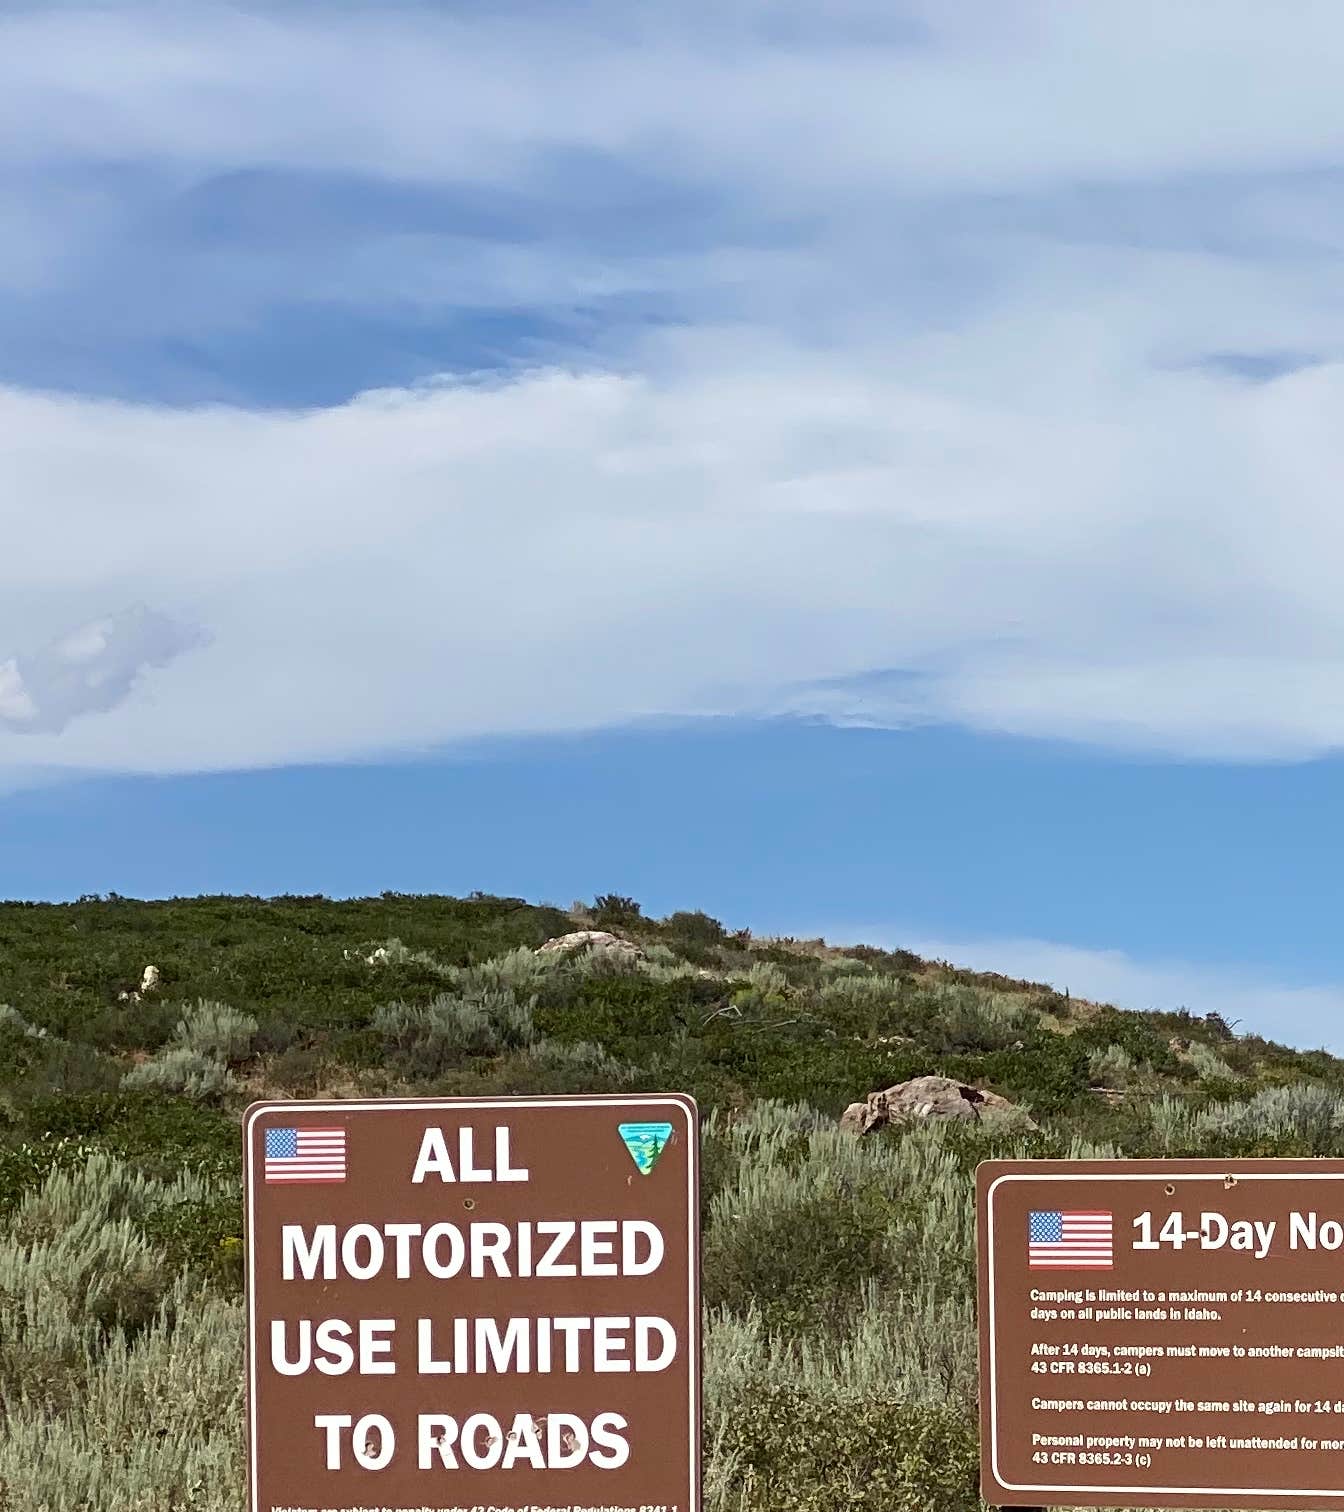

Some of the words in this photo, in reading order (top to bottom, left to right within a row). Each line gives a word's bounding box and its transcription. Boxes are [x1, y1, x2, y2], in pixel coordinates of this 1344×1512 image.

[411, 1126, 529, 1184] ALL
[1132, 1211, 1277, 1259] 14-Day
[282, 1220, 665, 1280] MOTORIZED
[1030, 1288, 1084, 1304] Camping
[1085, 1289, 1097, 1302] is
[1098, 1289, 1140, 1302] limited
[1142, 1289, 1156, 1302] to
[1168, 1289, 1228, 1302] maximum
[1230, 1289, 1243, 1302] of
[1245, 1289, 1263, 1303] 14
[1264, 1289, 1340, 1303] consecutive
[1030, 1306, 1058, 1322] days
[1059, 1309, 1076, 1320] on
[1077, 1307, 1093, 1320] all
[1095, 1307, 1133, 1322] public
[1134, 1307, 1168, 1321] lands
[1169, 1306, 1182, 1320] in
[1184, 1307, 1222, 1321] Idaho.
[271, 1318, 396, 1376] USE
[418, 1316, 677, 1374] LIMITED
[1030, 1343, 1061, 1356] After
[1062, 1343, 1079, 1357] 14
[1080, 1343, 1111, 1359] days,
[1113, 1346, 1165, 1359] campers
[1166, 1344, 1197, 1357] must
[1198, 1347, 1231, 1357] move
[1232, 1344, 1246, 1358] to
[1247, 1344, 1295, 1358] another
[1030, 1361, 1048, 1374] 43
[1049, 1361, 1075, 1374] CFR
[1077, 1361, 1133, 1375] 8365.1-2
[1134, 1362, 1152, 1377] (a)
[1031, 1397, 1085, 1413] Campers
[1086, 1398, 1128, 1411] cannot
[1130, 1400, 1173, 1414] occupy
[1174, 1399, 1195, 1412] the
[1196, 1401, 1230, 1412] same
[1232, 1399, 1256, 1413] site
[1257, 1399, 1292, 1415] again
[1294, 1399, 1312, 1413] for
[1313, 1400, 1332, 1414] 14
[314, 1413, 396, 1471] TO
[418, 1412, 630, 1470] ROADS
[1032, 1433, 1084, 1447] Personal
[1086, 1435, 1136, 1450] property
[1138, 1437, 1164, 1450] may
[1165, 1435, 1186, 1448] not
[1188, 1435, 1204, 1448] be
[1205, 1435, 1227, 1449] left
[1229, 1436, 1298, 1450] unattended
[1300, 1436, 1319, 1450] for
